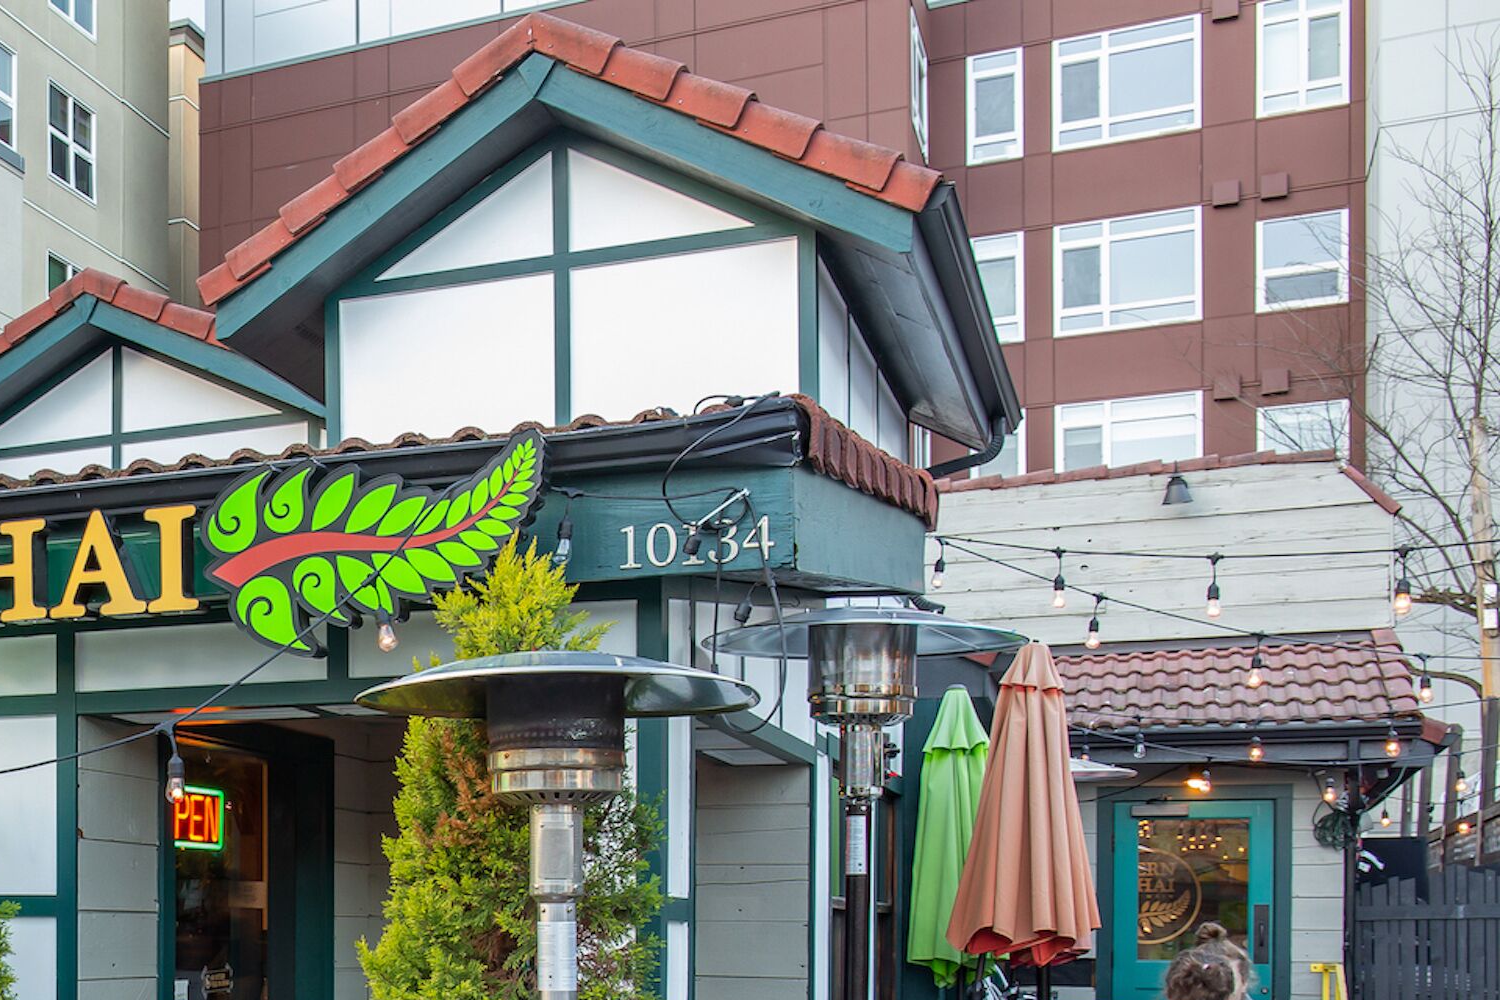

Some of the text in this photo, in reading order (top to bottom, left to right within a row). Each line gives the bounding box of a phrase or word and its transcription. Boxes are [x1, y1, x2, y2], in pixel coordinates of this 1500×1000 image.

[173, 794, 219, 843] PEN
[1138, 861, 1175, 877] ERN
[1138, 877, 1175, 893] HAI
